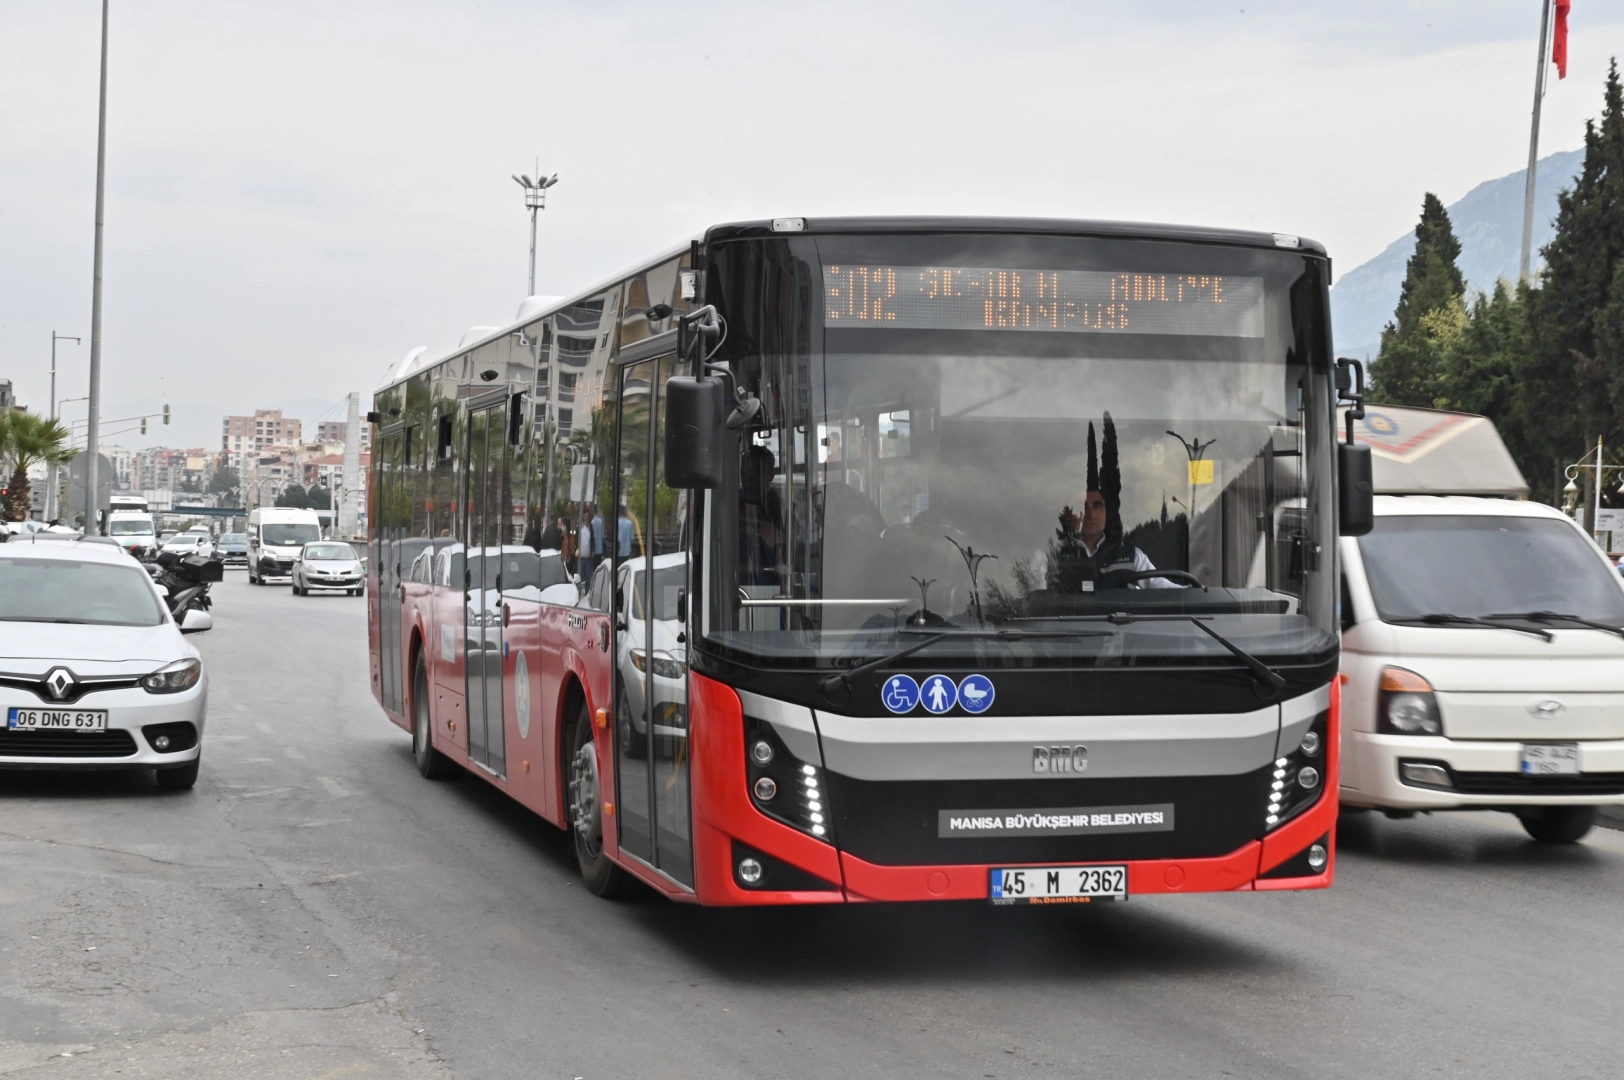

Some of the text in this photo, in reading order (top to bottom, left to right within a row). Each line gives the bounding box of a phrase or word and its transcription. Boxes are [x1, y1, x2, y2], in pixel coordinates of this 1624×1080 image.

[17, 711, 103, 728] 06 DNG 631
[1033, 745, 1088, 773] BMC
[950, 811, 1164, 830] MANİSA BÜYÜKŞEHİR BELEDİYESİ
[1003, 869, 1124, 895] 45 M 2362
